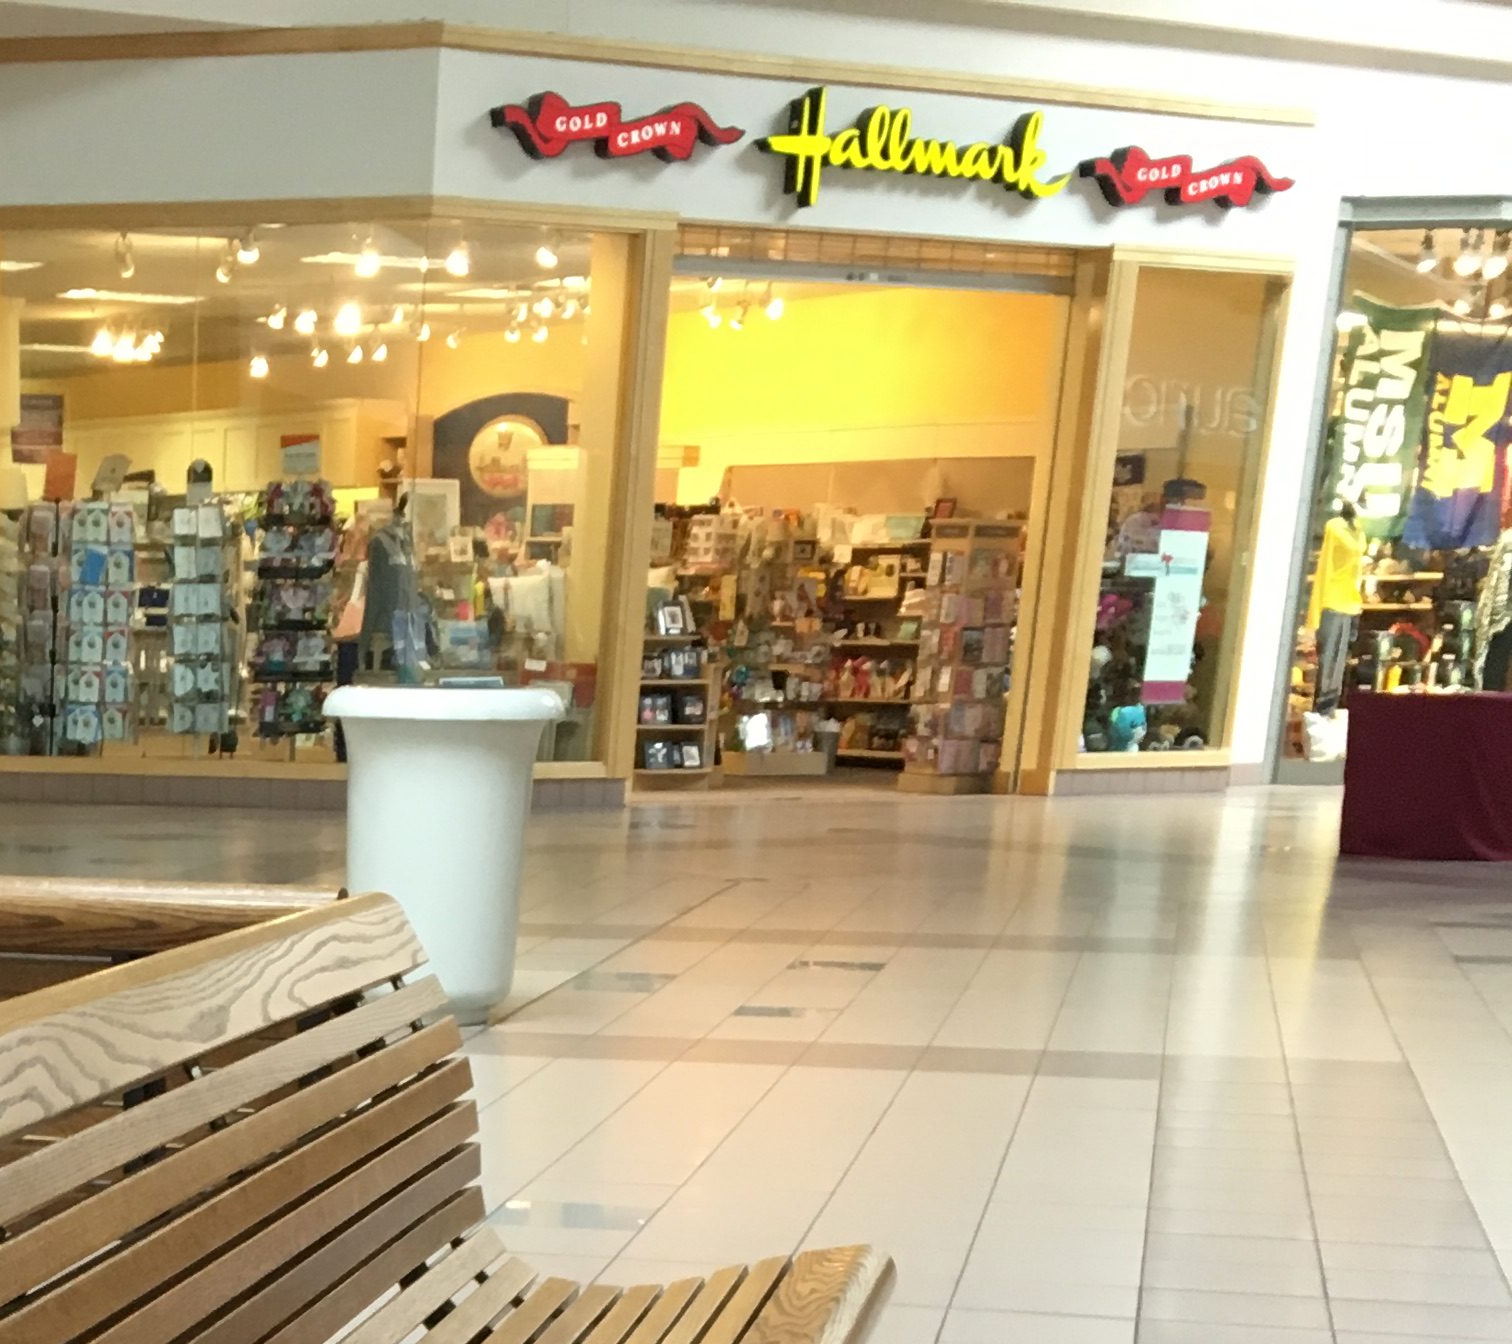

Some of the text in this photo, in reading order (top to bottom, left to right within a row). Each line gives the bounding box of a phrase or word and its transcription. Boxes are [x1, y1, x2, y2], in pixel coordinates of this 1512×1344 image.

[555, 112, 682, 148] GOLD CROWN
[768, 86, 1072, 206] Hallmark
[1137, 164, 1244, 196] GOLD CROWN
[1351, 330, 1426, 518] MSU
